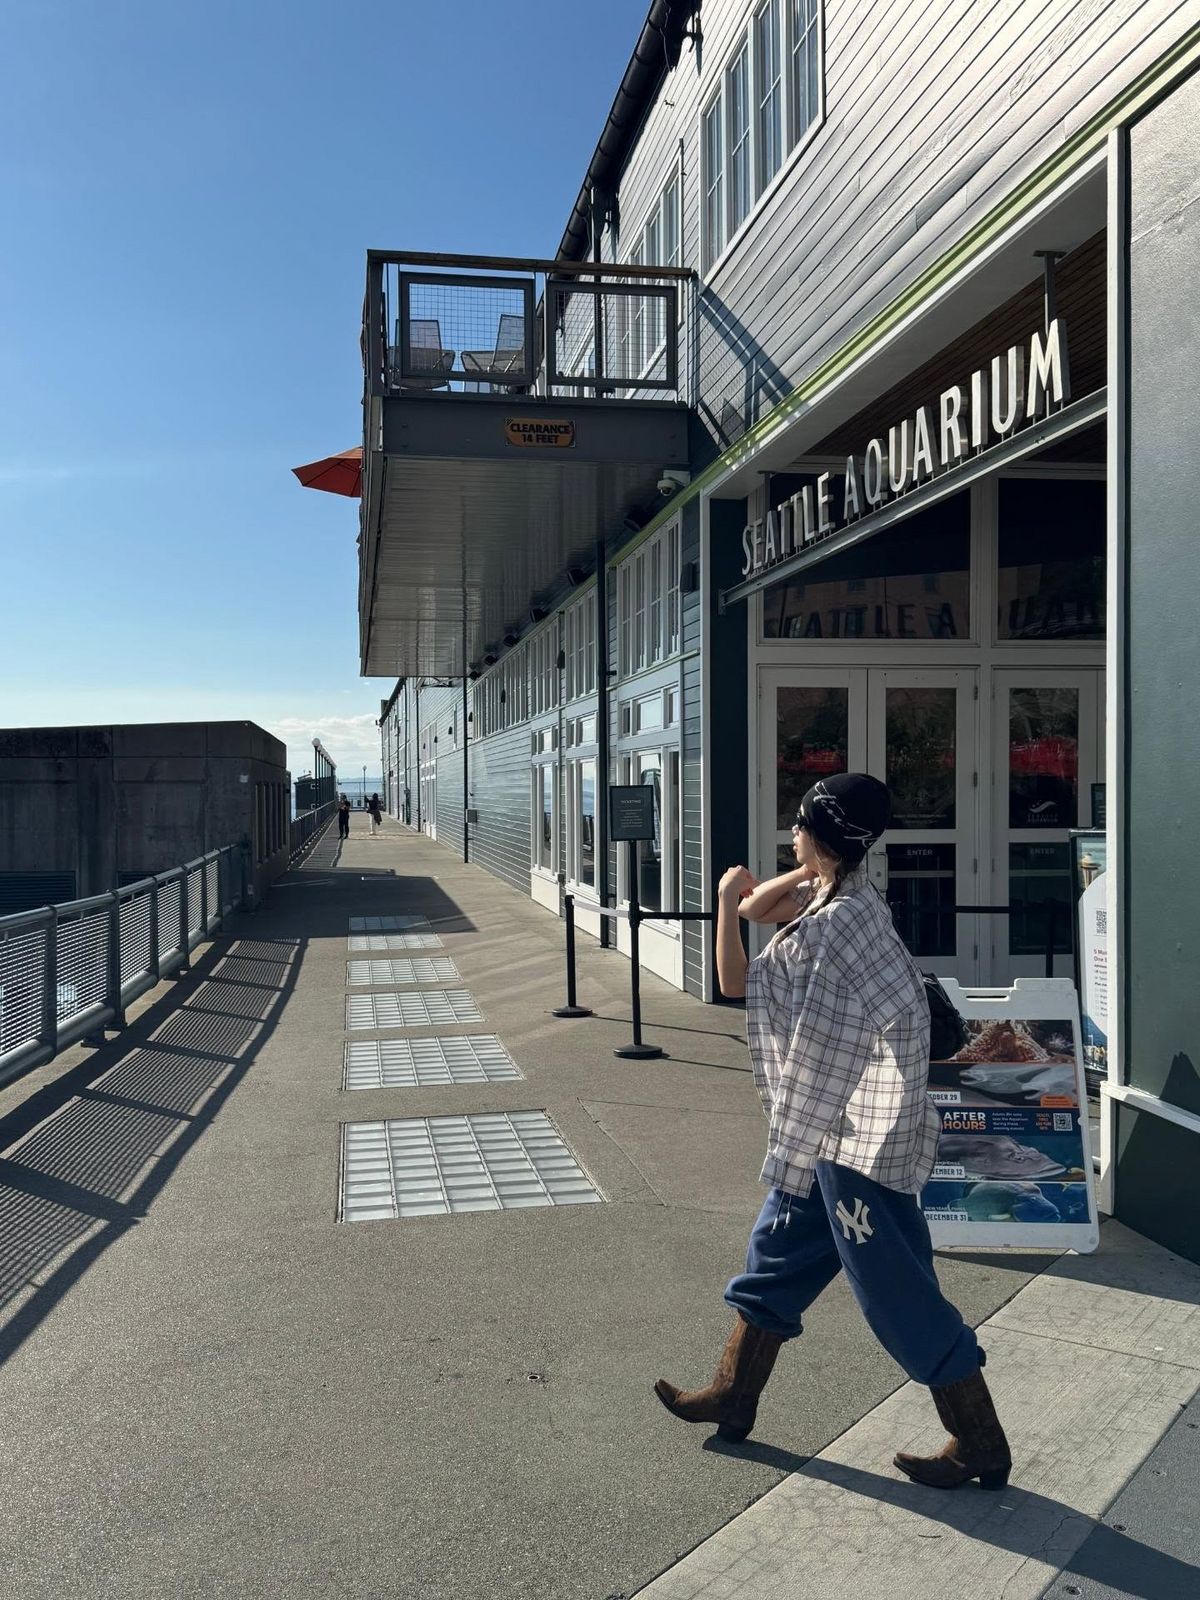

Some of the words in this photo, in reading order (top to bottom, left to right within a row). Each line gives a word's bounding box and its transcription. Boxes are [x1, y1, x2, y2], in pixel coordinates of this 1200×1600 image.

[510, 423, 570, 434] CLEARANCE
[522, 434, 533, 443] 14
[535, 434, 560, 443] FEET
[742, 471, 835, 575] SEATTLE
[843, 318, 1070, 520] AQUARIUM
[906, 848, 934, 856] ENTER
[943, 1111, 986, 1121] AFTER
[943, 1120, 986, 1131] HOURS
[835, 1197, 874, 1244] NY
[926, 1213, 958, 1221] DECEMBER
